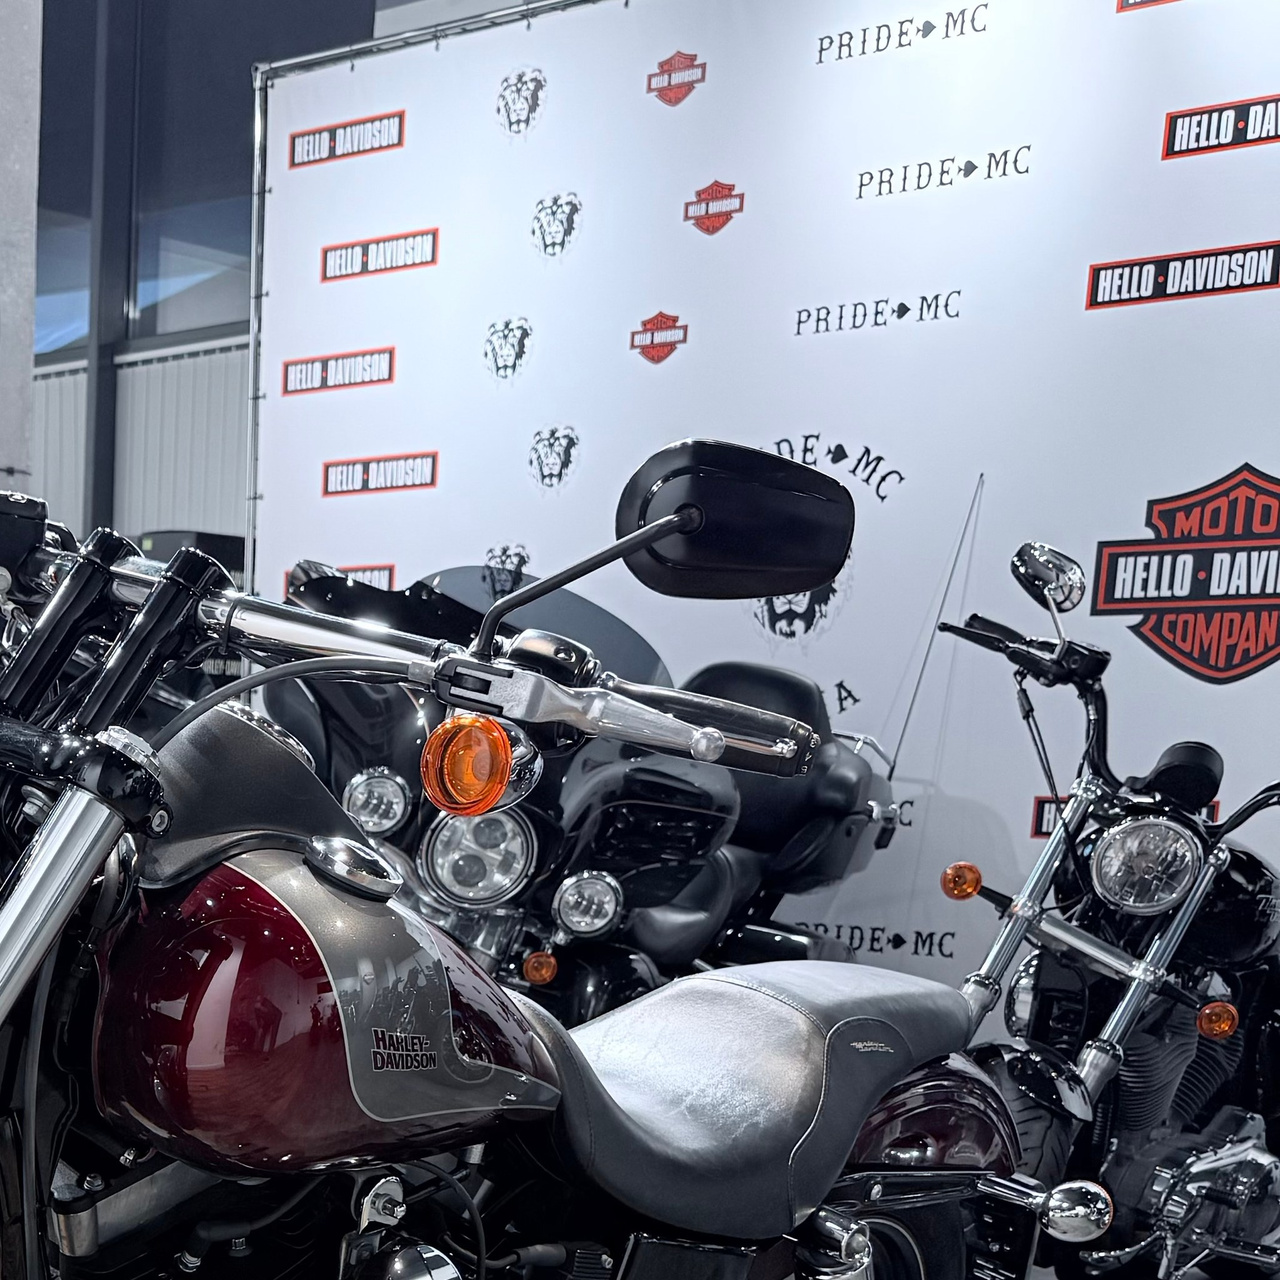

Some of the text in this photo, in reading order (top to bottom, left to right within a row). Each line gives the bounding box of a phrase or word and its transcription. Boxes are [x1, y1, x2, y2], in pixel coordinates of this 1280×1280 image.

[815, 3, 989, 65] PRIDE MC
[294, 115, 400, 164] HELLO DAVIDSON
[1174, 109, 1236, 152] HELLO
[856, 144, 1032, 200] PRIDE MC
[326, 233, 434, 278] HELLO DAVIDSON
[1097, 248, 1274, 302] HELLO DAVIDSON
[794, 289, 961, 336] PRIDE MC
[287, 351, 391, 391] HELLO DAVIDSON
[327, 455, 433, 492] HELLO DAVIDSON
[848, 445, 905, 503] MC
[1113, 554, 1194, 599] HELLO
[911, 930, 956, 959] MC
[371, 1028, 430, 1053] HARLEY-
[371, 1050, 438, 1071] DAVIDSON
